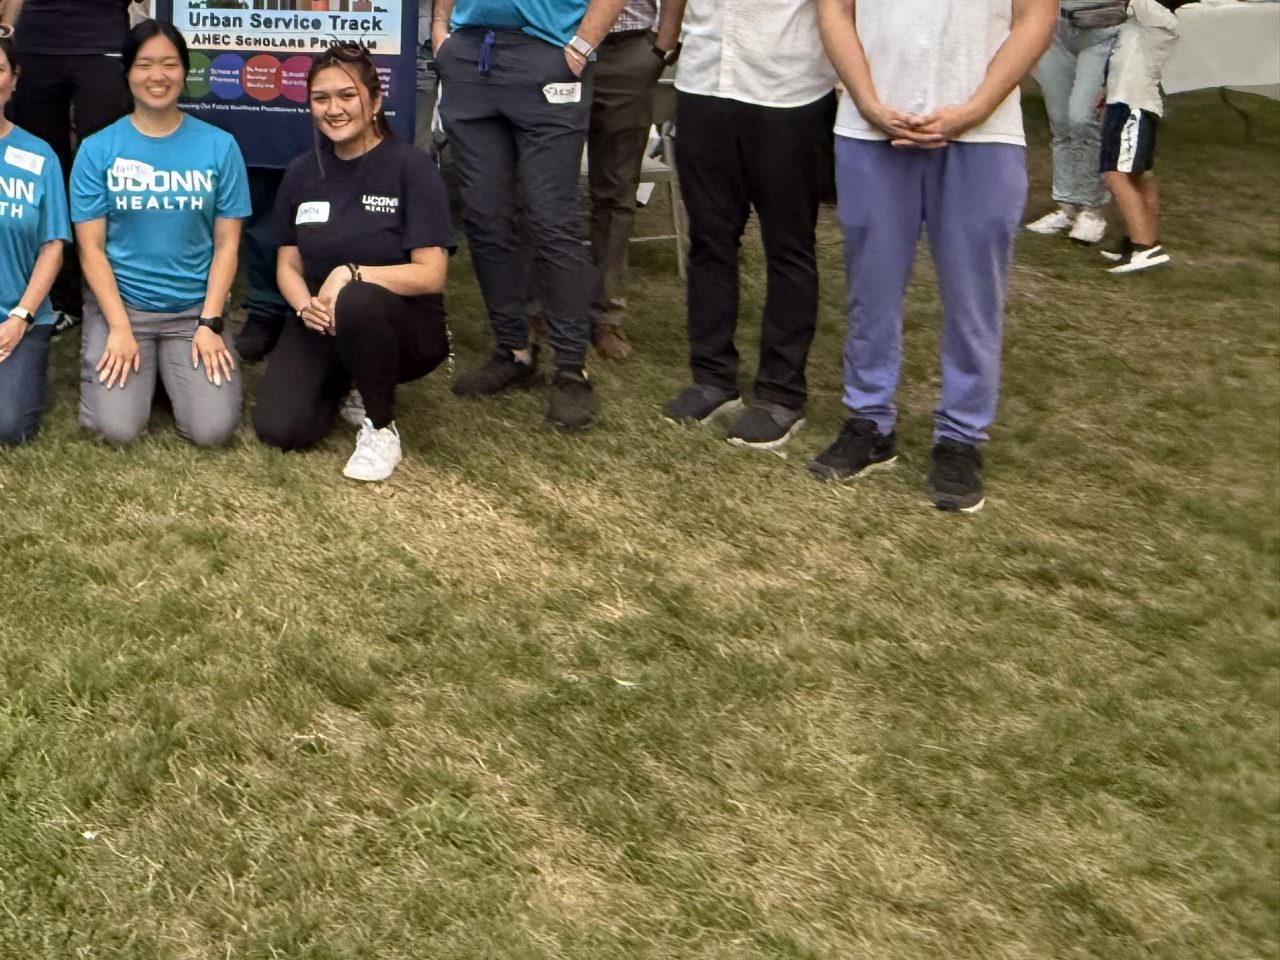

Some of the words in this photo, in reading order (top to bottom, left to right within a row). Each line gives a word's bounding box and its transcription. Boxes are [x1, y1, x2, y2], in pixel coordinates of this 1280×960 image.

[188, 11, 243, 28] Urban
[250, 13, 322, 30] Service
[328, 15, 383, 31] Track
[192, 33, 231, 46] AHEC
[115, 195, 203, 210] HEALTH
